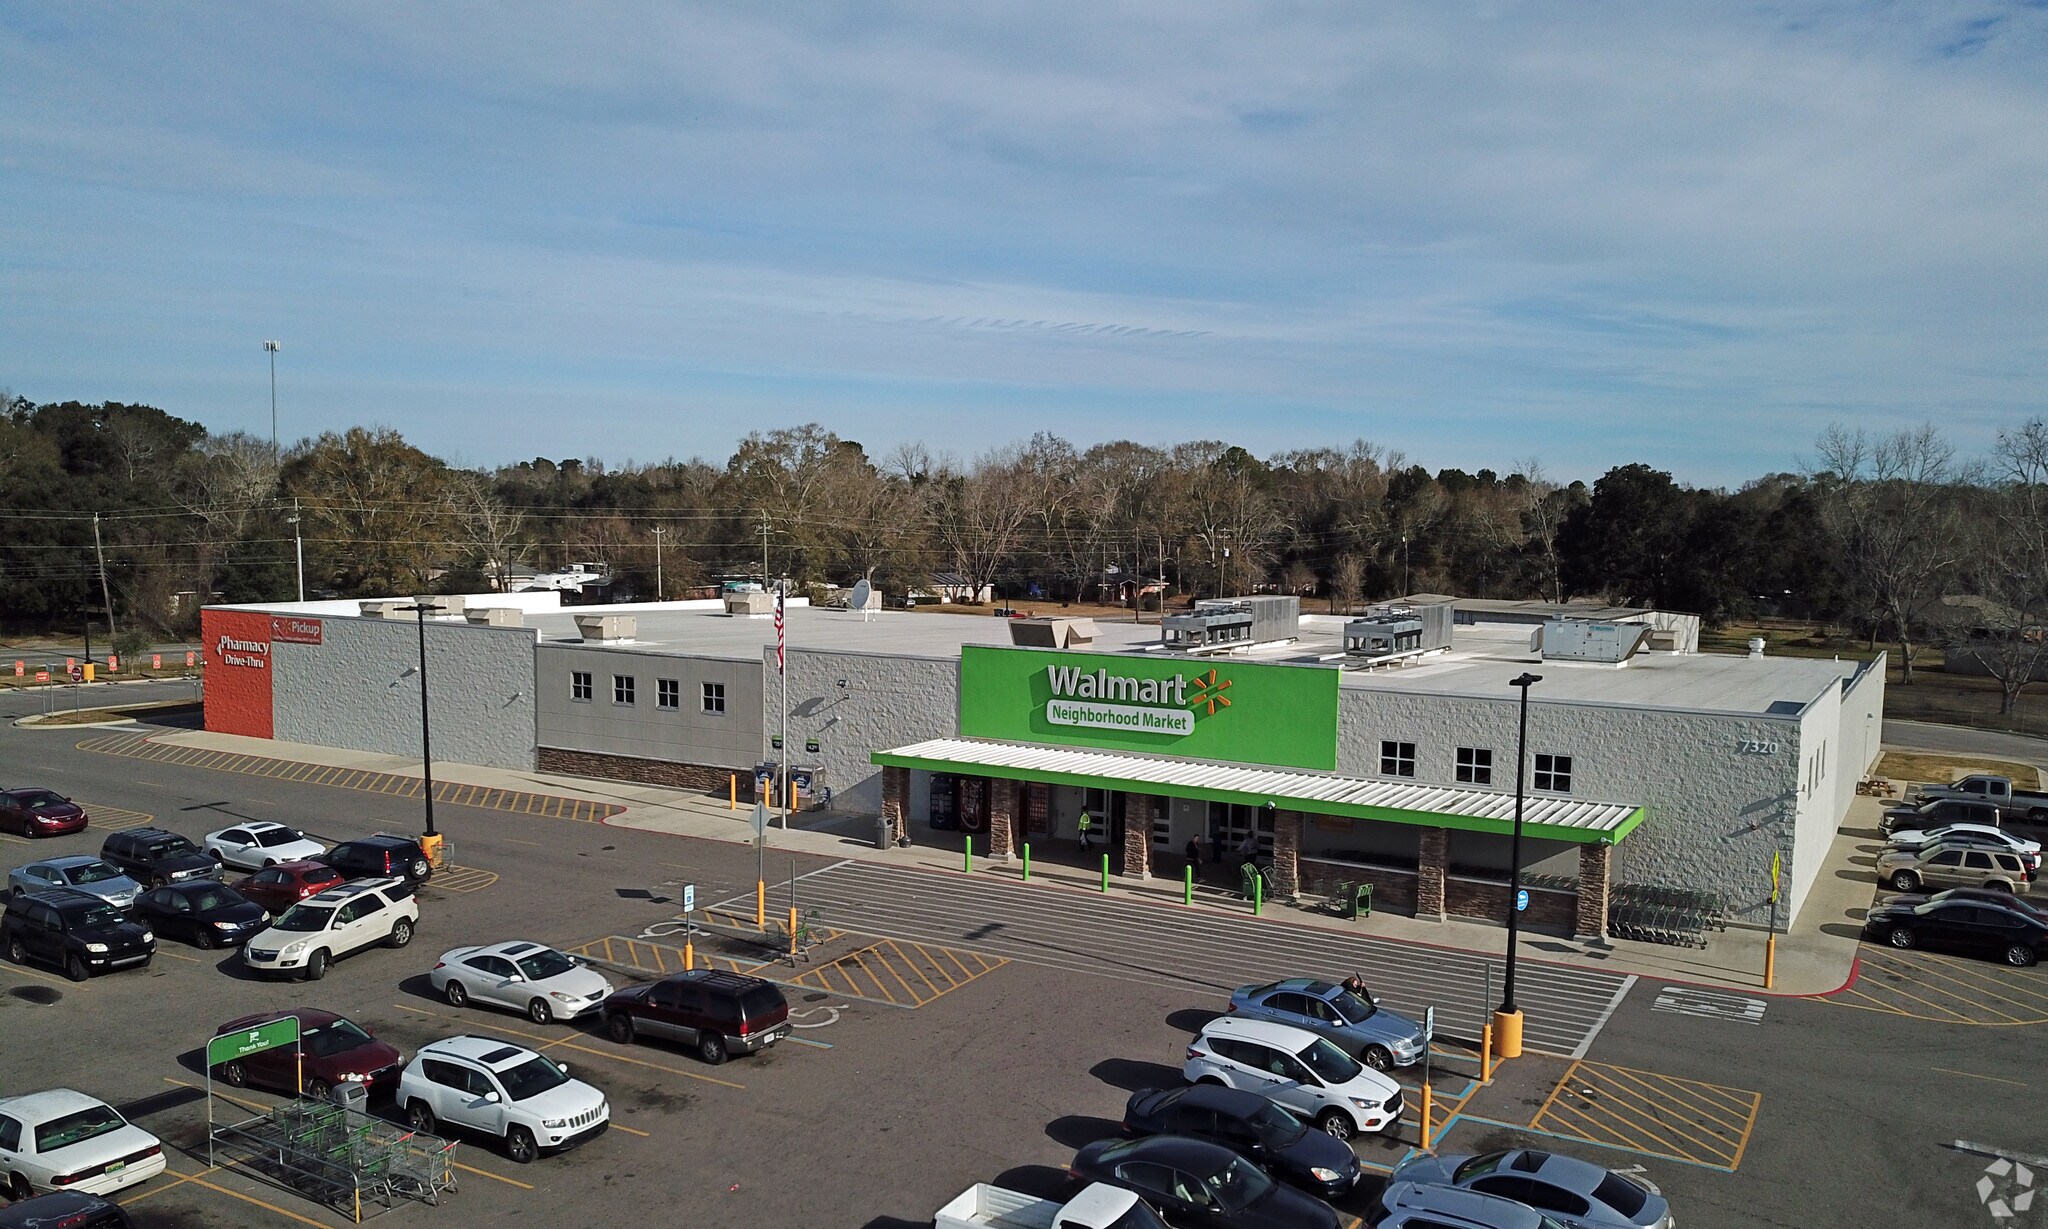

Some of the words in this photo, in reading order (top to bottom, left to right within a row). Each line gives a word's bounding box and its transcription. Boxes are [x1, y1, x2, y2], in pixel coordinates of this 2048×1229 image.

[291, 620, 320, 637] Pickup
[220, 635, 270, 656] Pharmacy
[225, 654, 264, 668] Drive-Thru
[1047, 664, 1187, 706] Walmart
[1052, 705, 1139, 726] Neighborhood
[1142, 712, 1187, 731] Market
[1739, 738, 1779, 754] 7320
[239, 1045, 256, 1053] Thank
